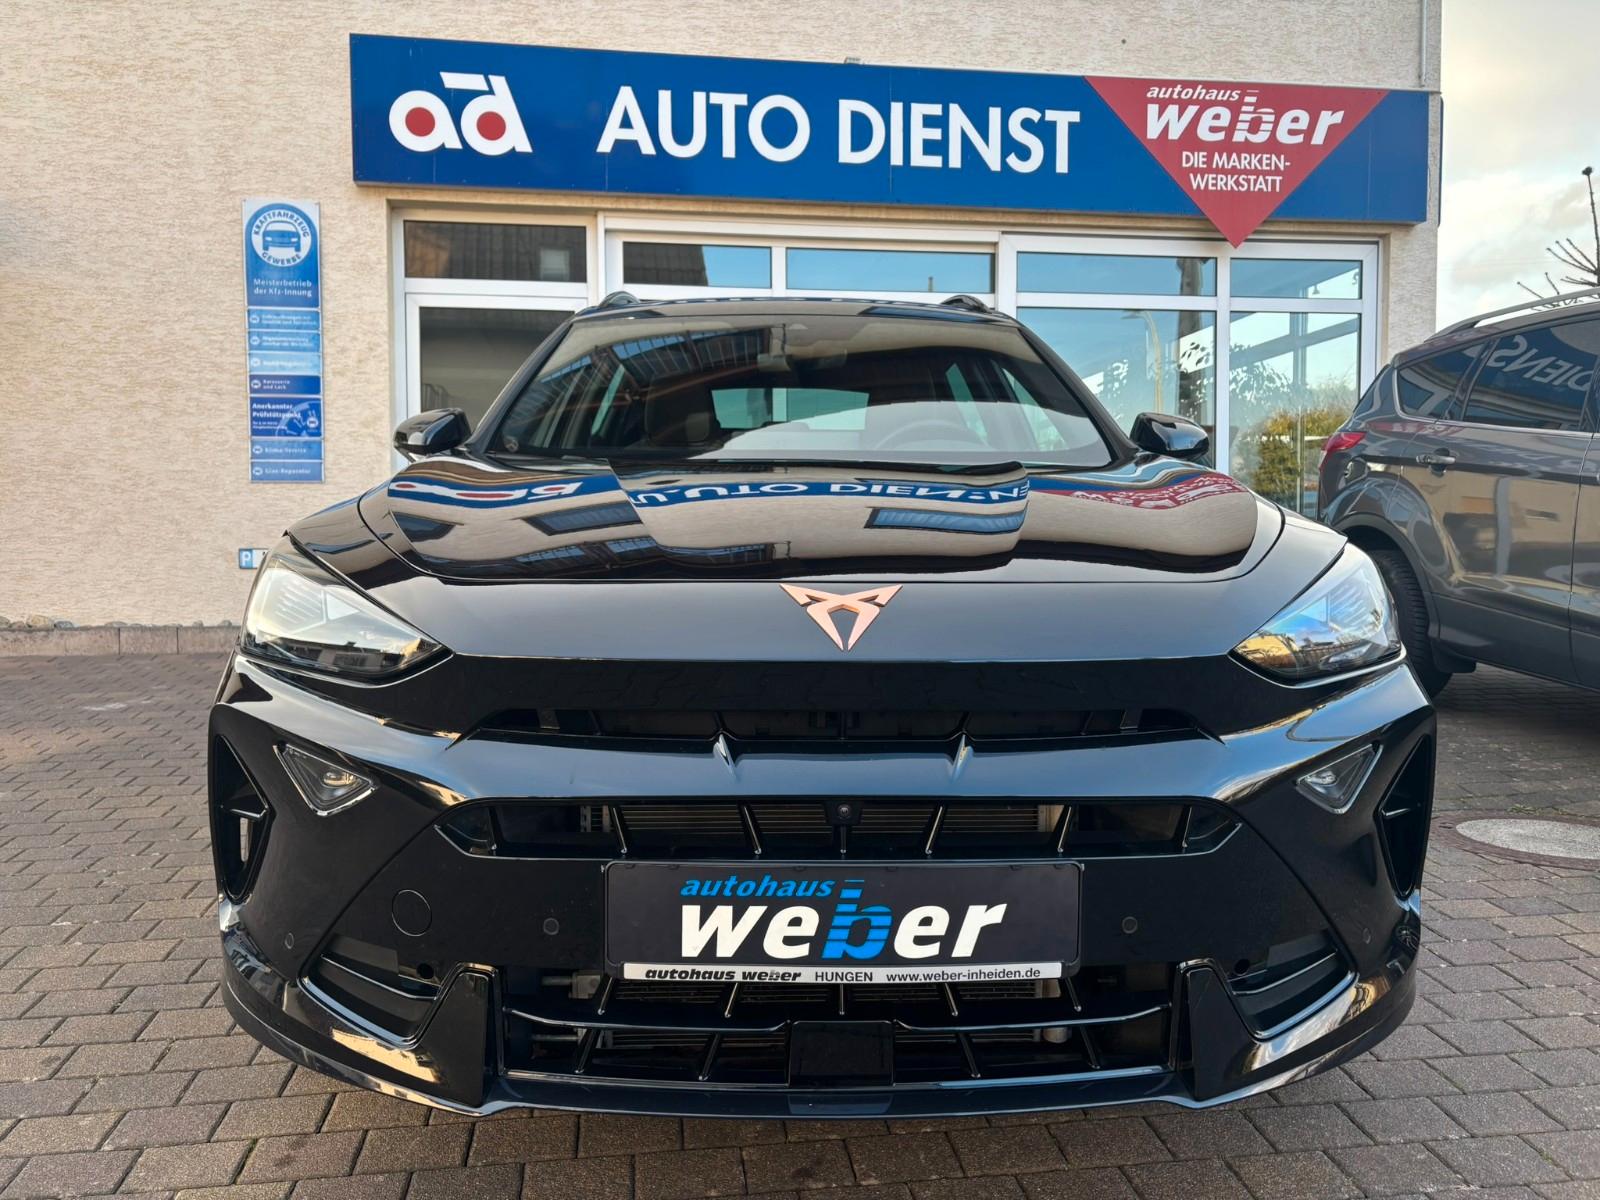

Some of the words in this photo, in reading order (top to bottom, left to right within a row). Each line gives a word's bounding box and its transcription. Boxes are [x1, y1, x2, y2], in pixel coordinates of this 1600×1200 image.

[1146, 84, 1241, 102] autohaus
[1146, 89, 1345, 146] weber
[596, 85, 811, 163] AUTO
[838, 99, 1081, 175] DIENST
[1181, 151, 1209, 169] DIE
[1211, 153, 1292, 172] MARKEN-
[1189, 173, 1283, 193] WERKSTATT
[253, 278, 312, 288] Meisterbetrieb
[254, 287, 267, 295] der
[241, 551, 252, 567] P
[680, 875, 834, 898] autohaus
[681, 879, 1008, 960] weber
[644, 967, 736, 982] autohaus
[741, 970, 802, 982] weber
[814, 970, 874, 983] HUNGEN
[885, 966, 1042, 983] www.weber-inheiden.de
